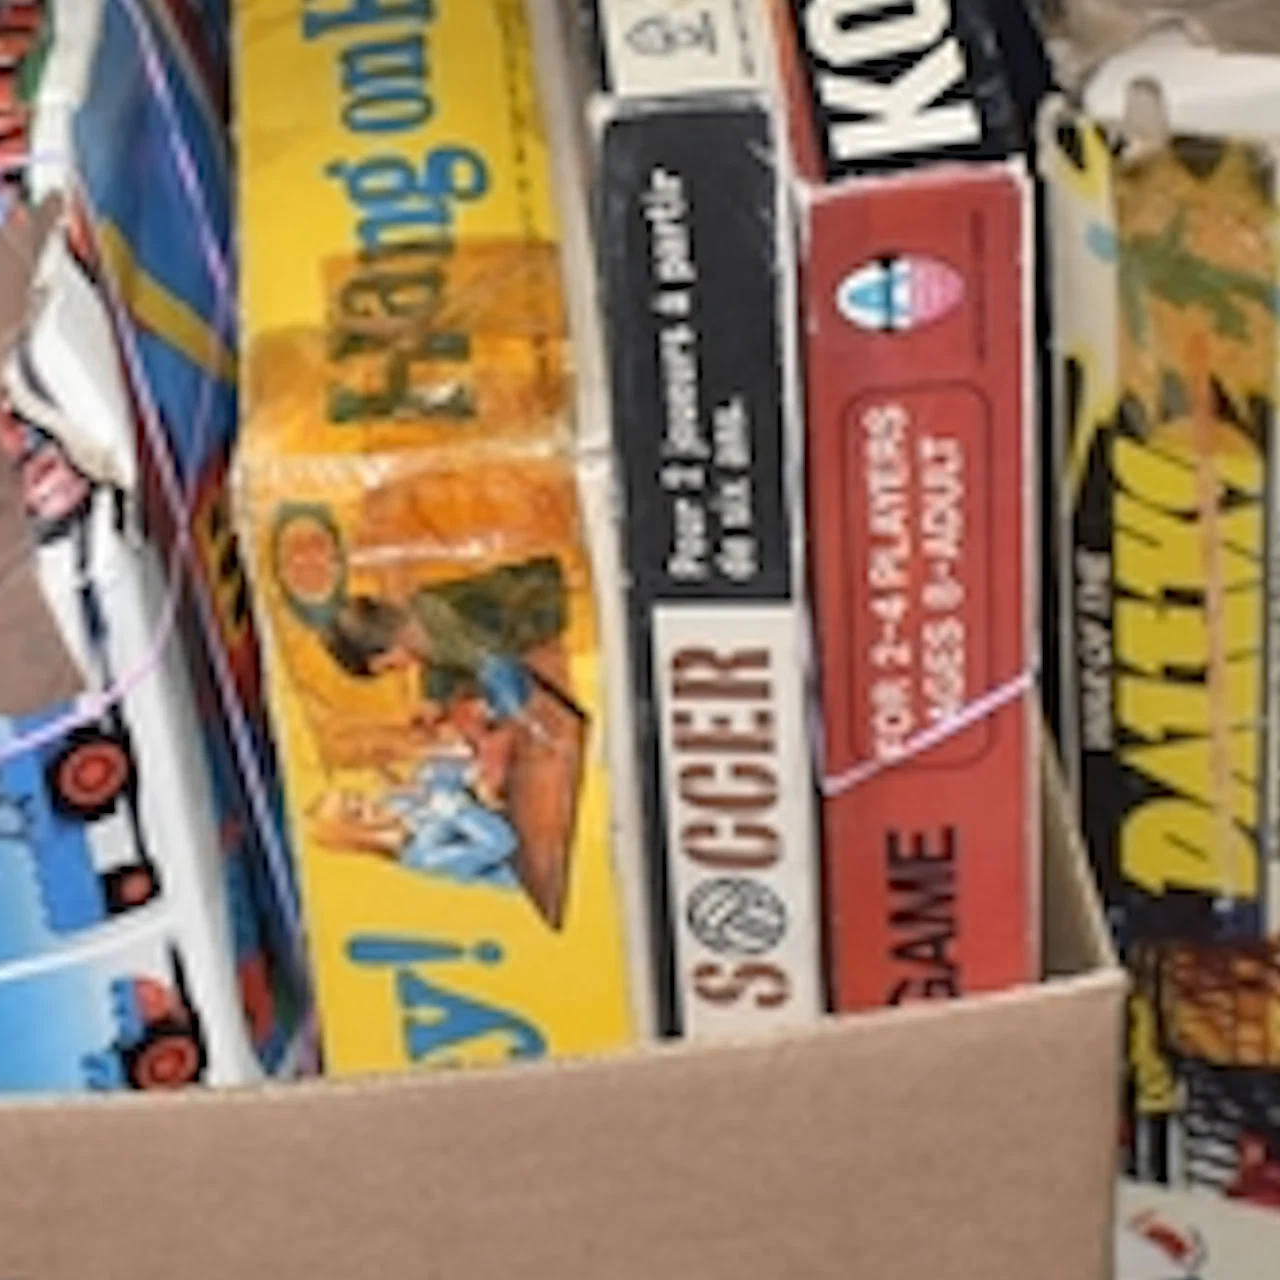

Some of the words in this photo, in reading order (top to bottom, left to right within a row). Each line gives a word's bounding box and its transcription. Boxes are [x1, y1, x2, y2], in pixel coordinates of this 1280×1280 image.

[338, 34, 435, 133] on
[640, 166, 698, 281] partir
[324, 144, 490, 423] Hang
[658, 323, 711, 446] joueurs
[668, 522, 711, 579] Pour
[715, 477, 754, 528] six
[860, 403, 913, 590] PLAYERS
[871, 698, 914, 759] FOR
[671, 645, 791, 1010] SOCCER
[885, 824, 962, 1007] GAME
